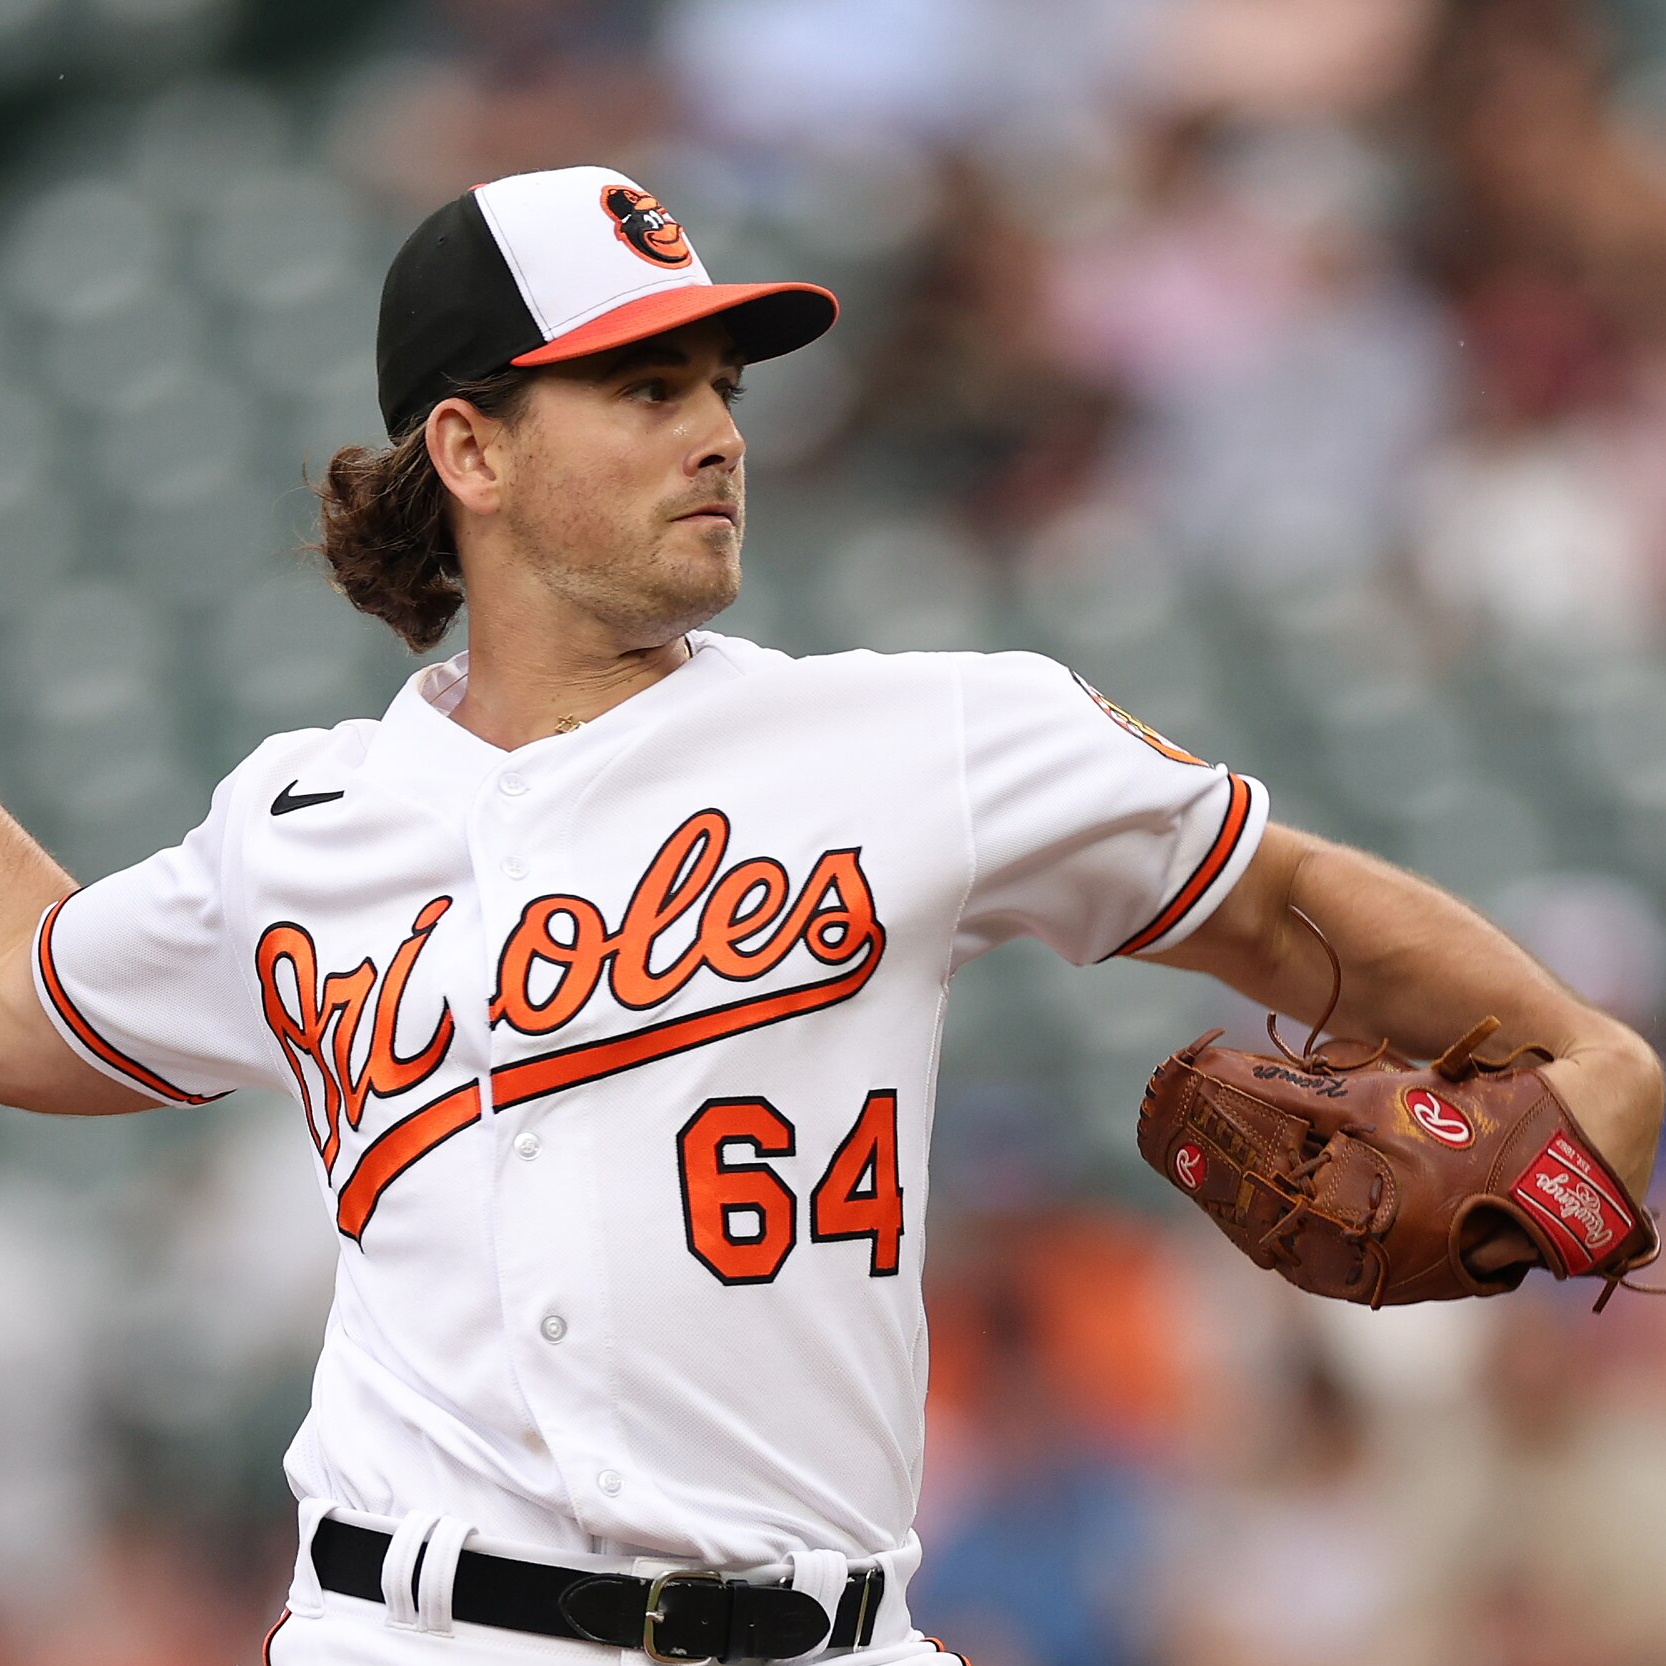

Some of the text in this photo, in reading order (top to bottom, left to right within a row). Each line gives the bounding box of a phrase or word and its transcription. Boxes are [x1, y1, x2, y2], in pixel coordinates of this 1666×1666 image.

[255, 807, 886, 1187] Orioles
[1414, 1091, 1470, 1143] R
[676, 1088, 904, 1286] 64
[1176, 1148, 1202, 1189] R
[1535, 1173, 1614, 1249] Rawlings
